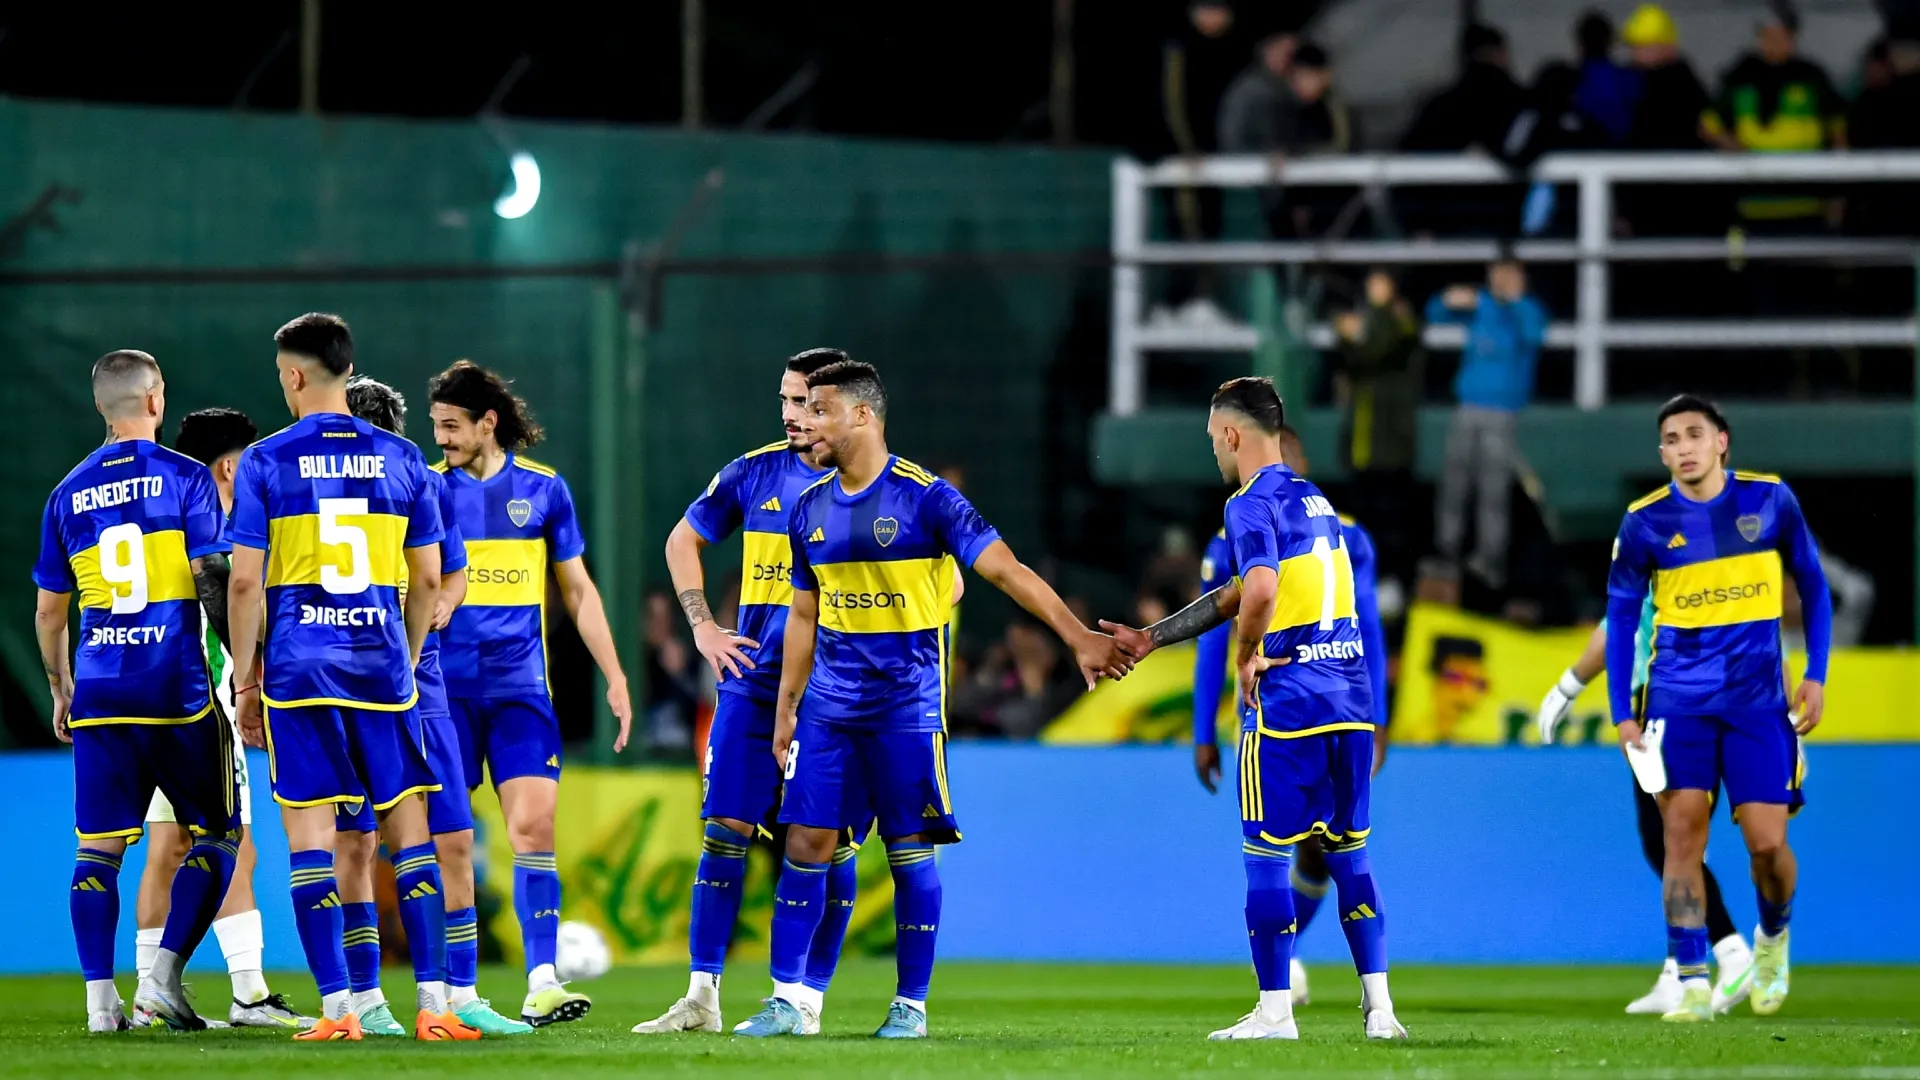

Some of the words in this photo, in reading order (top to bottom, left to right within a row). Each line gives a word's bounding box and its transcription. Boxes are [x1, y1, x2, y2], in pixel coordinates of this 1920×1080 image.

[298, 455, 386, 479] BULLAUDE
[71, 475, 163, 515] BENEDETTO
[318, 498, 371, 594] 5
[99, 522, 149, 614] 9
[1674, 582, 1770, 610] betsson
[299, 604, 387, 627] DIRECTV
